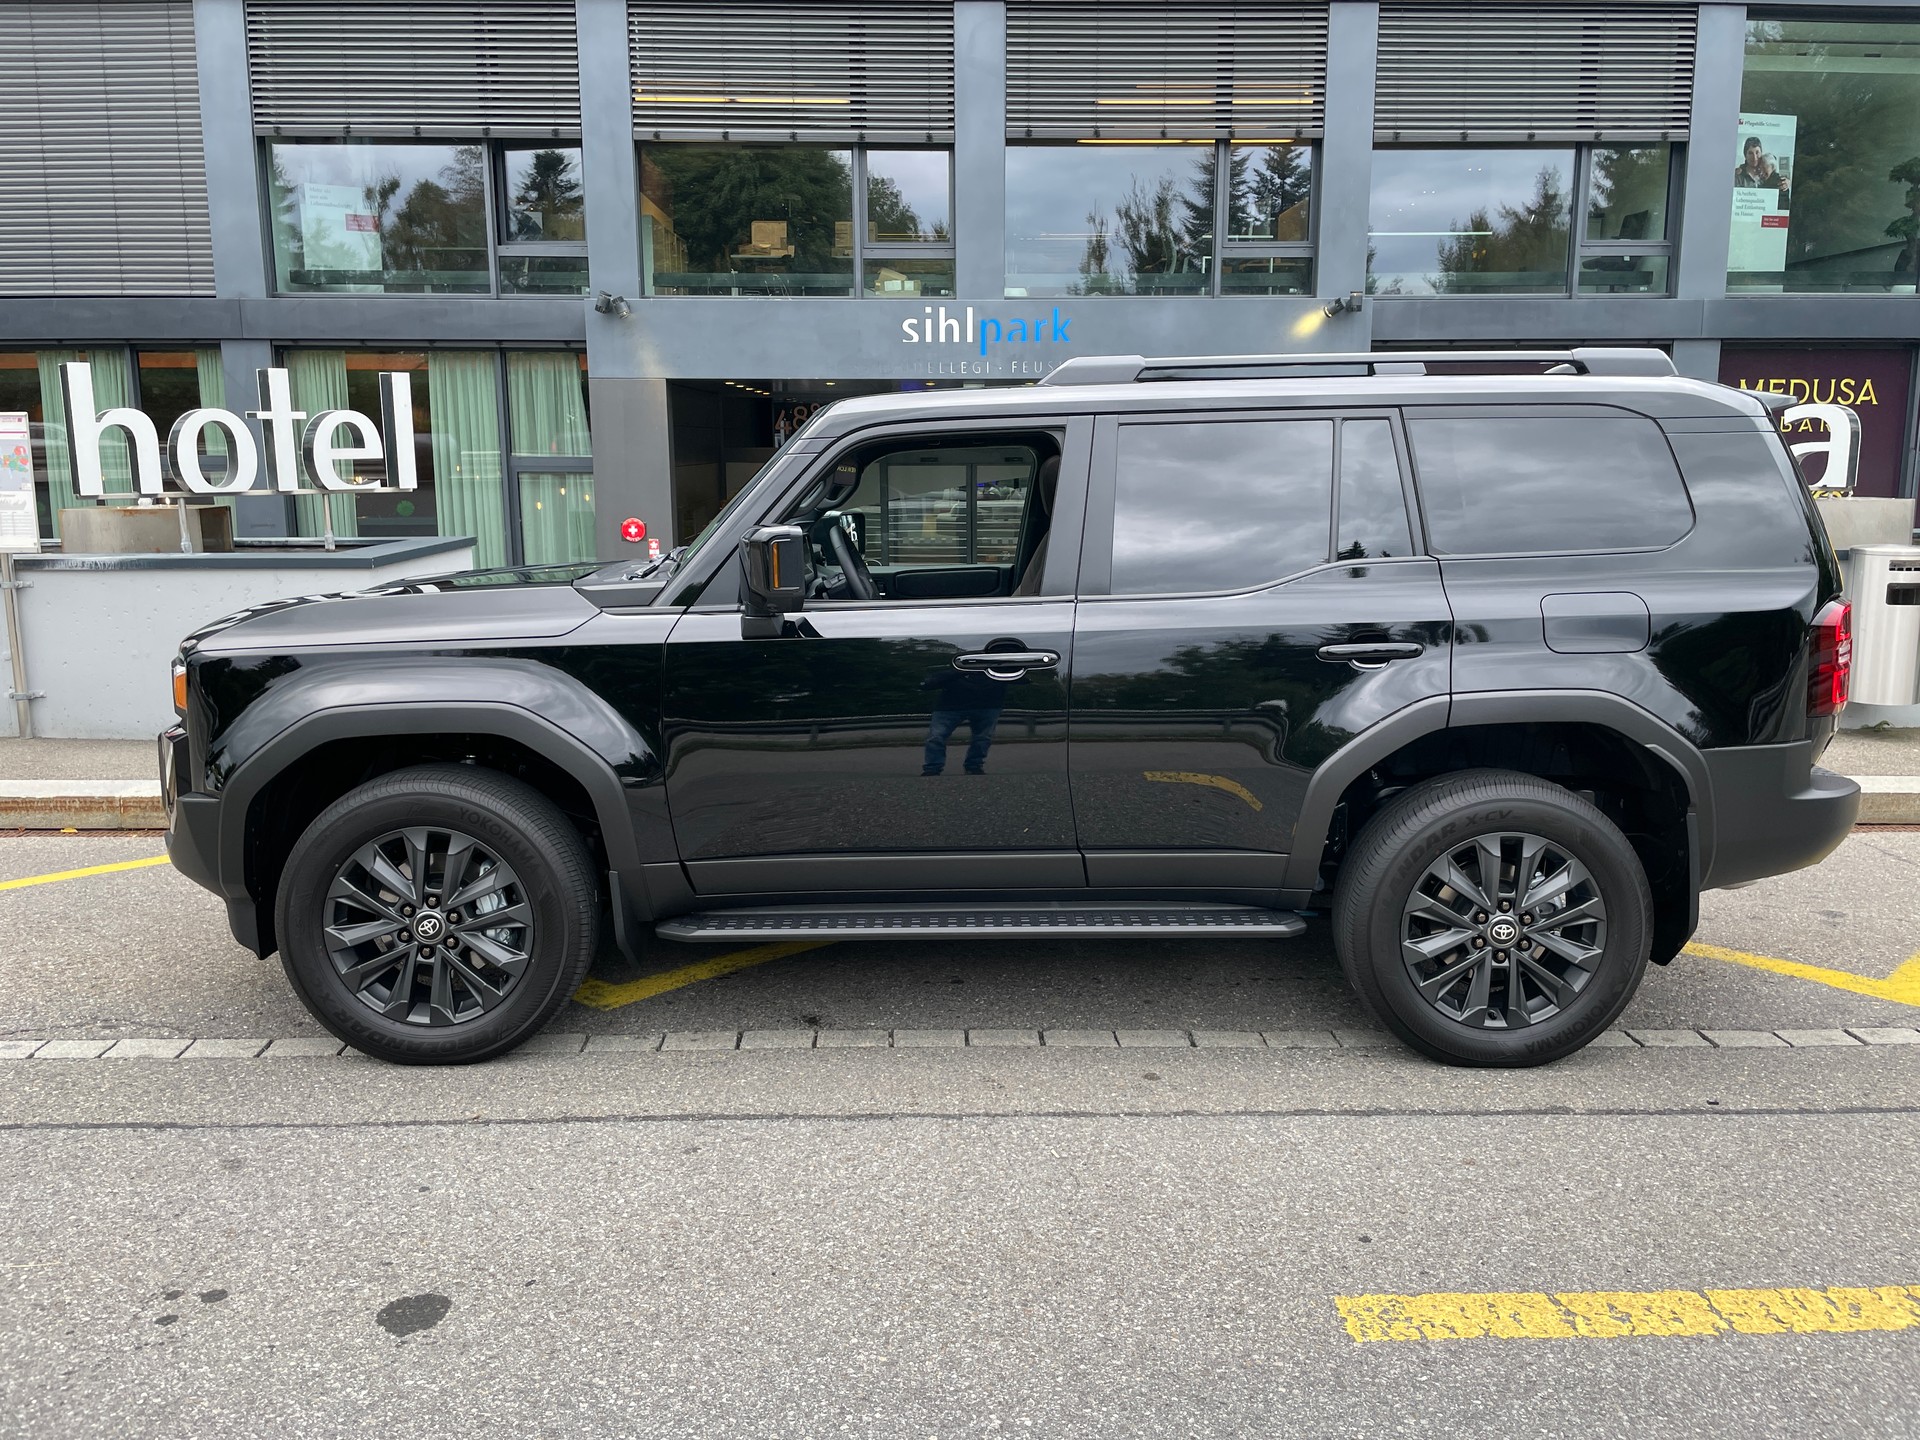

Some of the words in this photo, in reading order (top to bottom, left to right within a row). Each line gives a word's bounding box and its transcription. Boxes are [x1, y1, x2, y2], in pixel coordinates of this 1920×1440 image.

[901, 306, 1072, 357] sihlpark
[1011, 361, 1062, 374] FEUS
[59, 361, 417, 496] hotel
